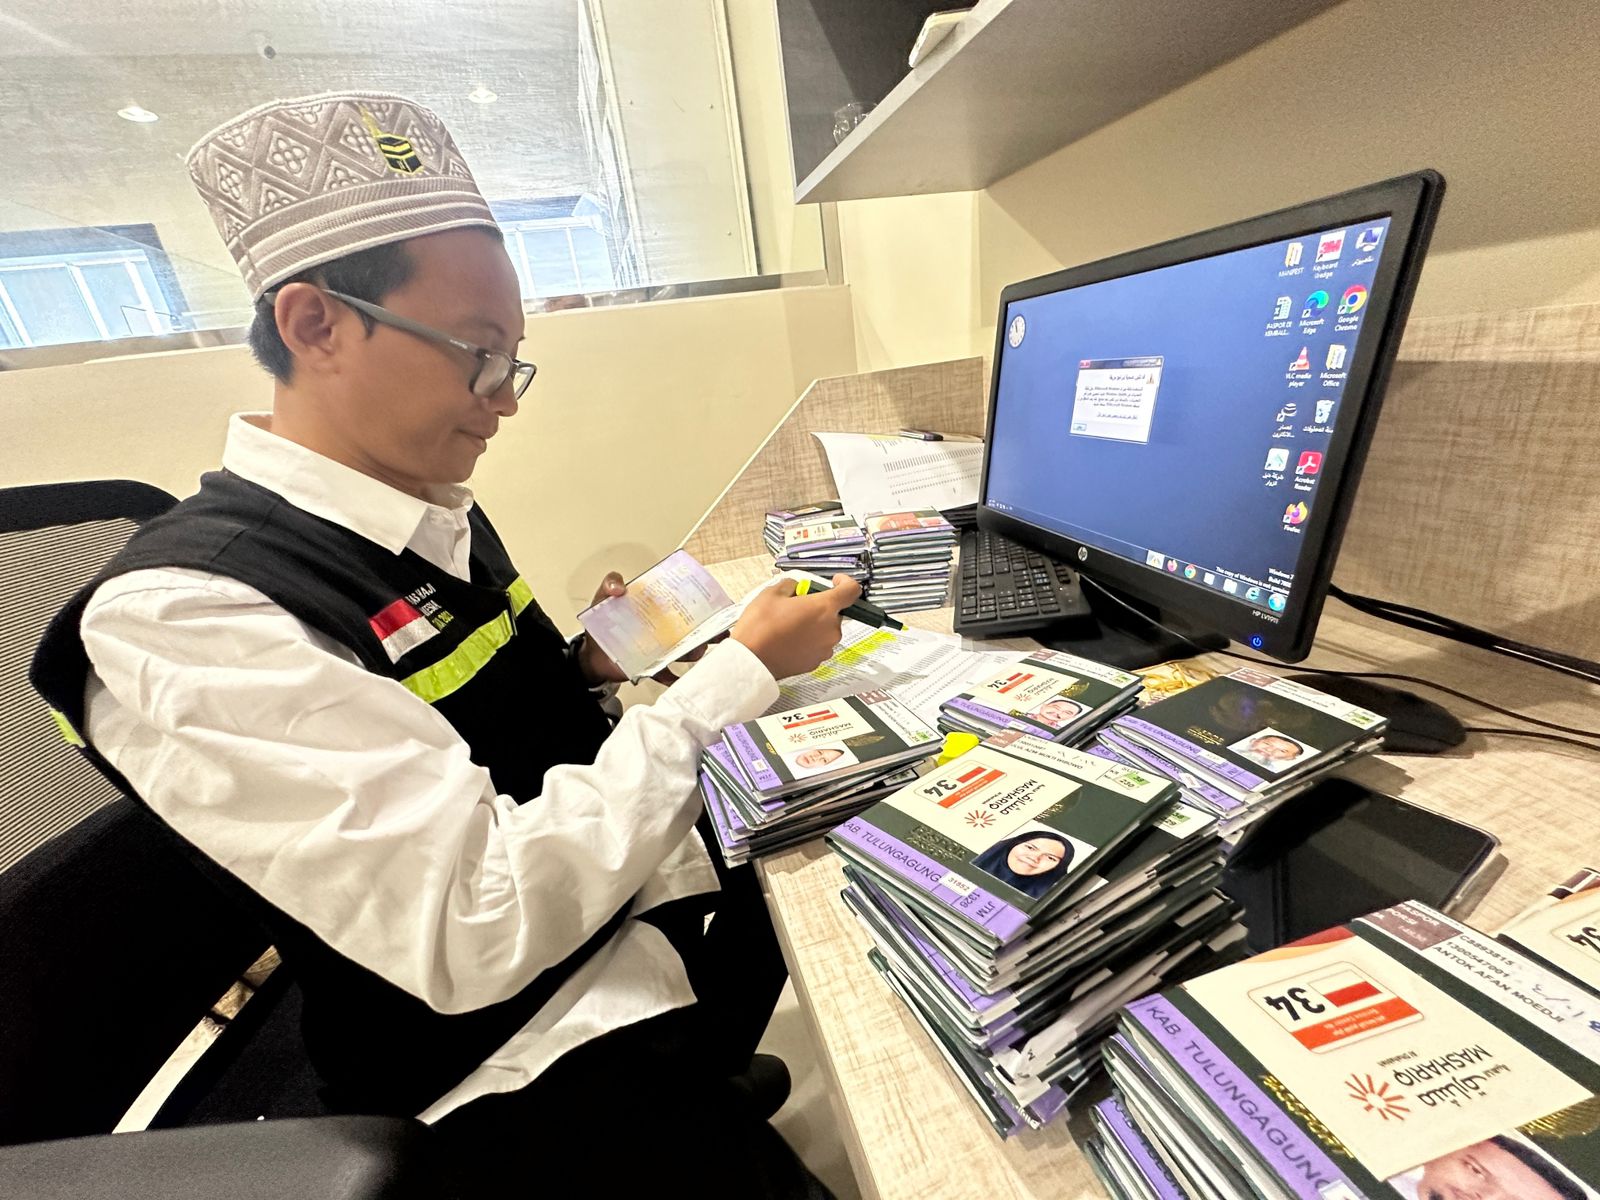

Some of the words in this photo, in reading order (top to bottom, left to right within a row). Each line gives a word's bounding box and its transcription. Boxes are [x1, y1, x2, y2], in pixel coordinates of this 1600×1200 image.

[1338, 316, 1358, 324] Google
[1268, 568, 1290, 579] Windows
[782, 713, 804, 723] 34
[923, 779, 957, 797] 34
[989, 779, 1038, 810] MASHARIQ
[861, 832, 942, 883] TULUNGAGUNG
[976, 901, 996, 918] JTM
[1432, 946, 1477, 971] ANTOK
[1474, 970, 1513, 991] AFAN
[1511, 991, 1565, 1023] MOEDJI
[1263, 987, 1326, 1021] 34
[1392, 1044, 1493, 1087] MASHARIQ
[1417, 1074, 1488, 1108] مشارق
